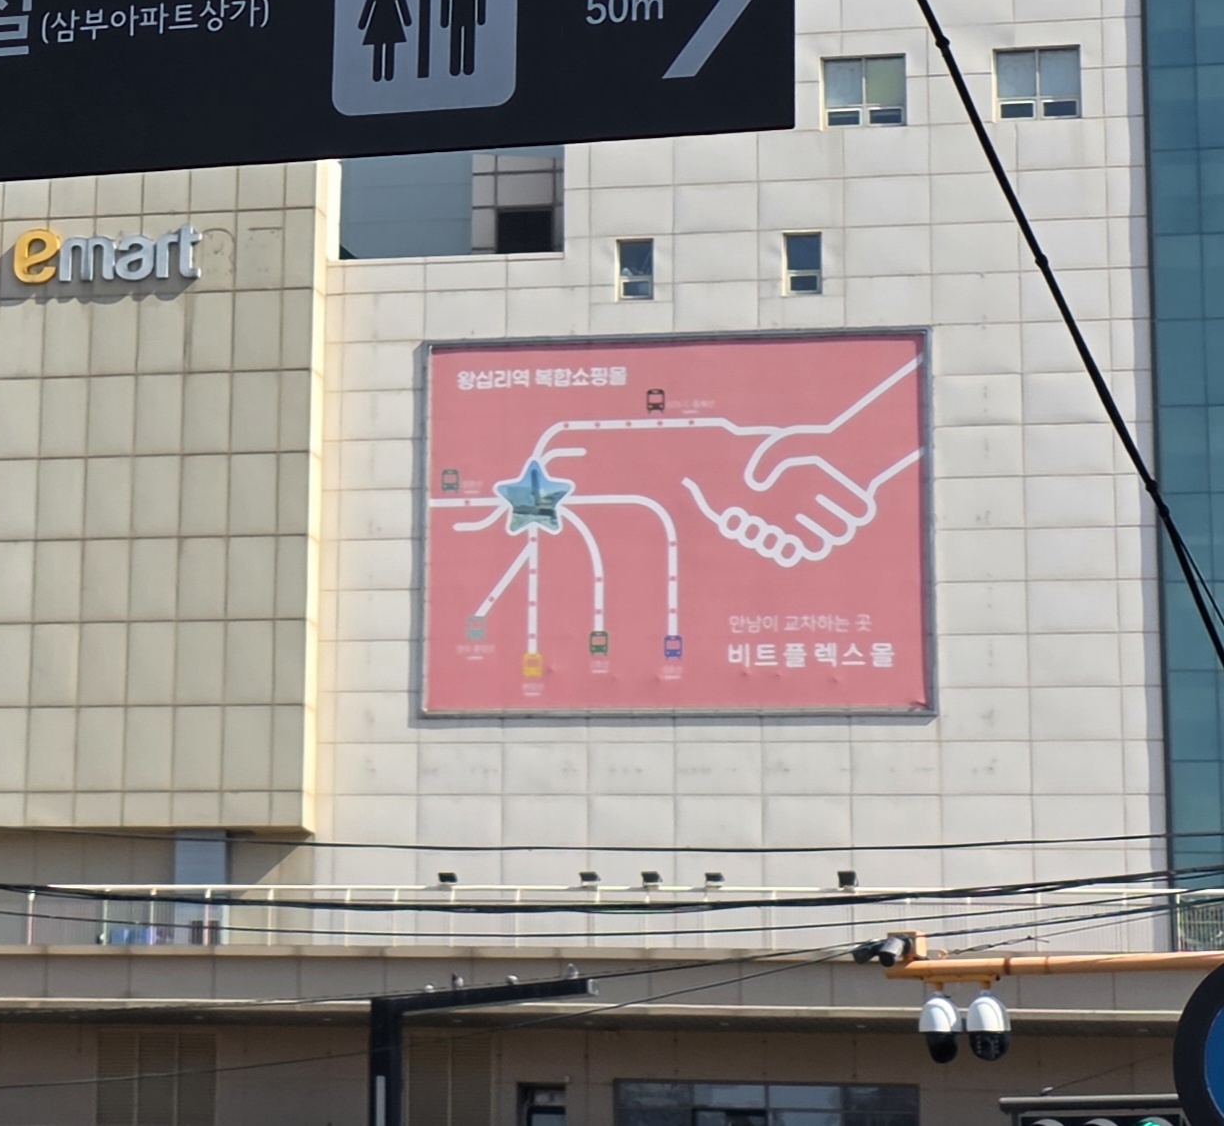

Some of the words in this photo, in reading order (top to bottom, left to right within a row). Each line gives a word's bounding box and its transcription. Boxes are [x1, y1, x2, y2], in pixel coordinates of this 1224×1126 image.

[12, 222, 203, 284] emart
[457, 369, 530, 391] 왕십리역
[535, 366, 628, 387] 복합쇼핑몰
[783, 614, 850, 633] 교차하는
[728, 642, 895, 668] 비트플렉스몰
